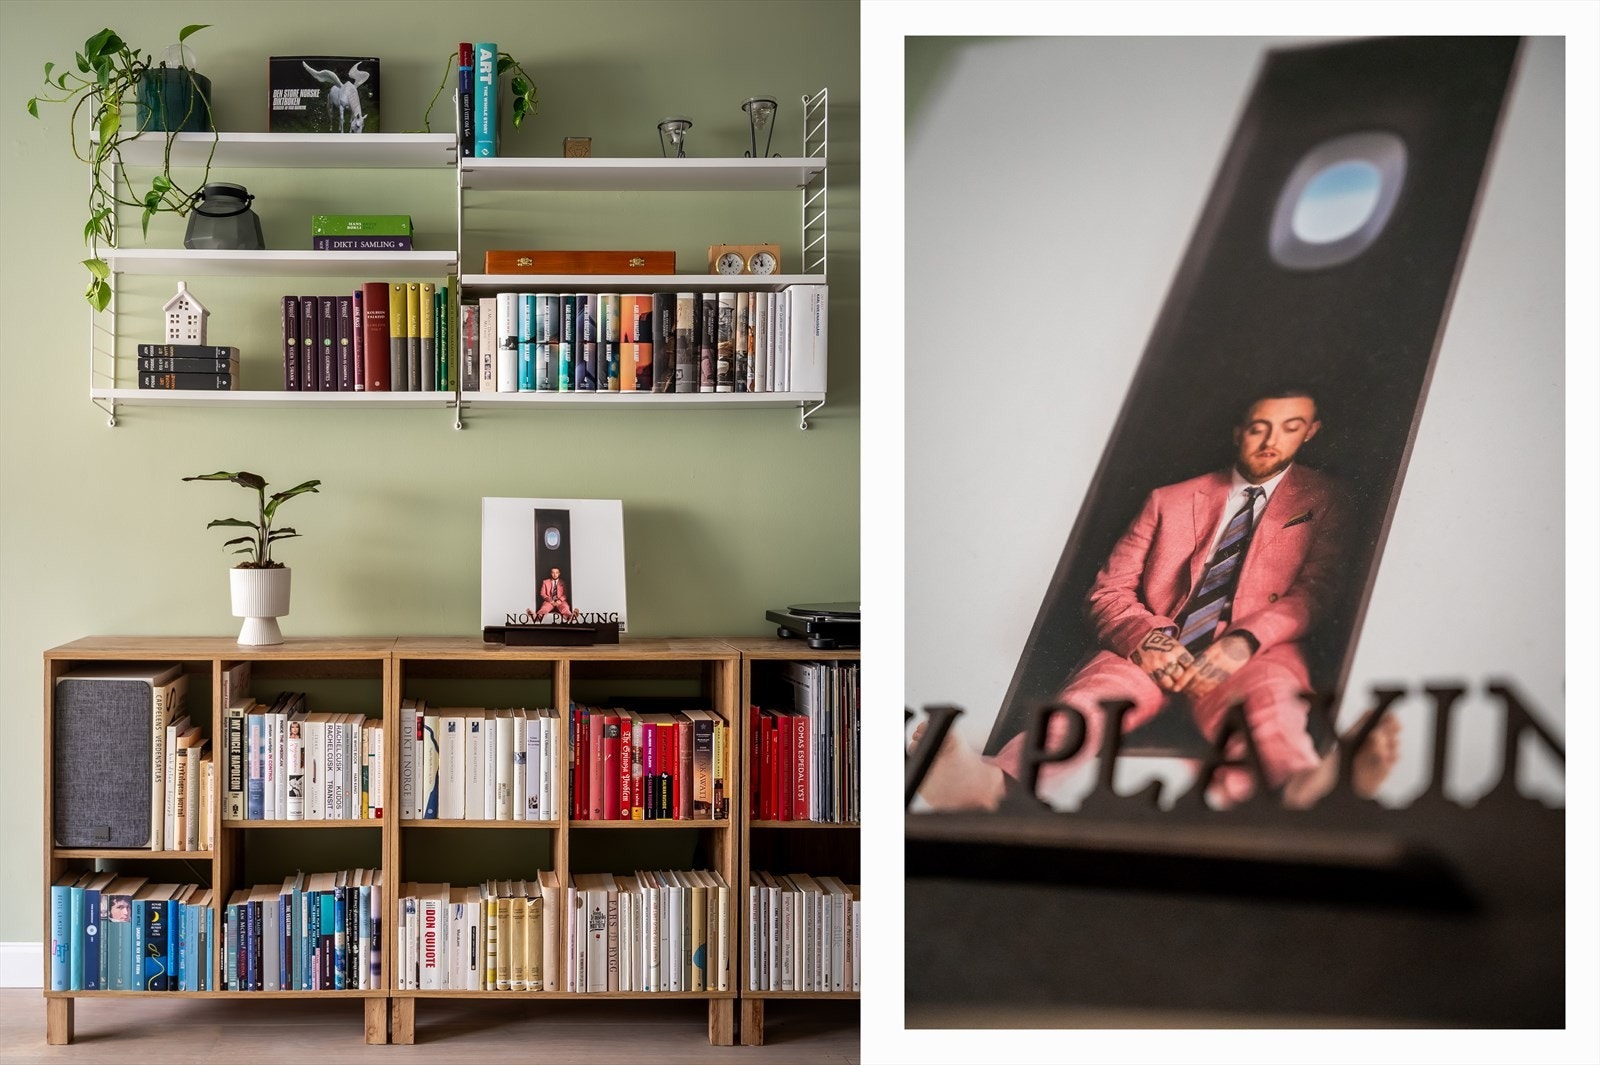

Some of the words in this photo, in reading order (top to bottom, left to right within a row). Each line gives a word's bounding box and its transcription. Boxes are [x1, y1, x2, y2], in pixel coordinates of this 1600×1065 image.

[480, 48, 492, 85] ART
[273, 89, 284, 98] DEN
[284, 89, 300, 98] STORE
[300, 89, 320, 98] NORSKE
[506, 612, 545, 624] NOW
[552, 612, 618, 624] PLAYING
[154, 694, 163, 731] CAPPELENS
[231, 720, 241, 730] MY
[231, 732, 241, 754] UNCLE
[404, 726, 412, 751] DIKT
[621, 731, 632, 742] The
[154, 735, 163, 784] VERDENSATLAS
[621, 745, 632, 772] Spinoza
[178, 762, 186, 796] Psykologens
[231, 755, 241, 790] NAPOLEON
[404, 760, 412, 797] NORGE
[621, 775, 632, 802] Problem
[178, 797, 186, 818] journal
[426, 910, 436, 928] DON
[426, 932, 436, 968] QUIJOTE
